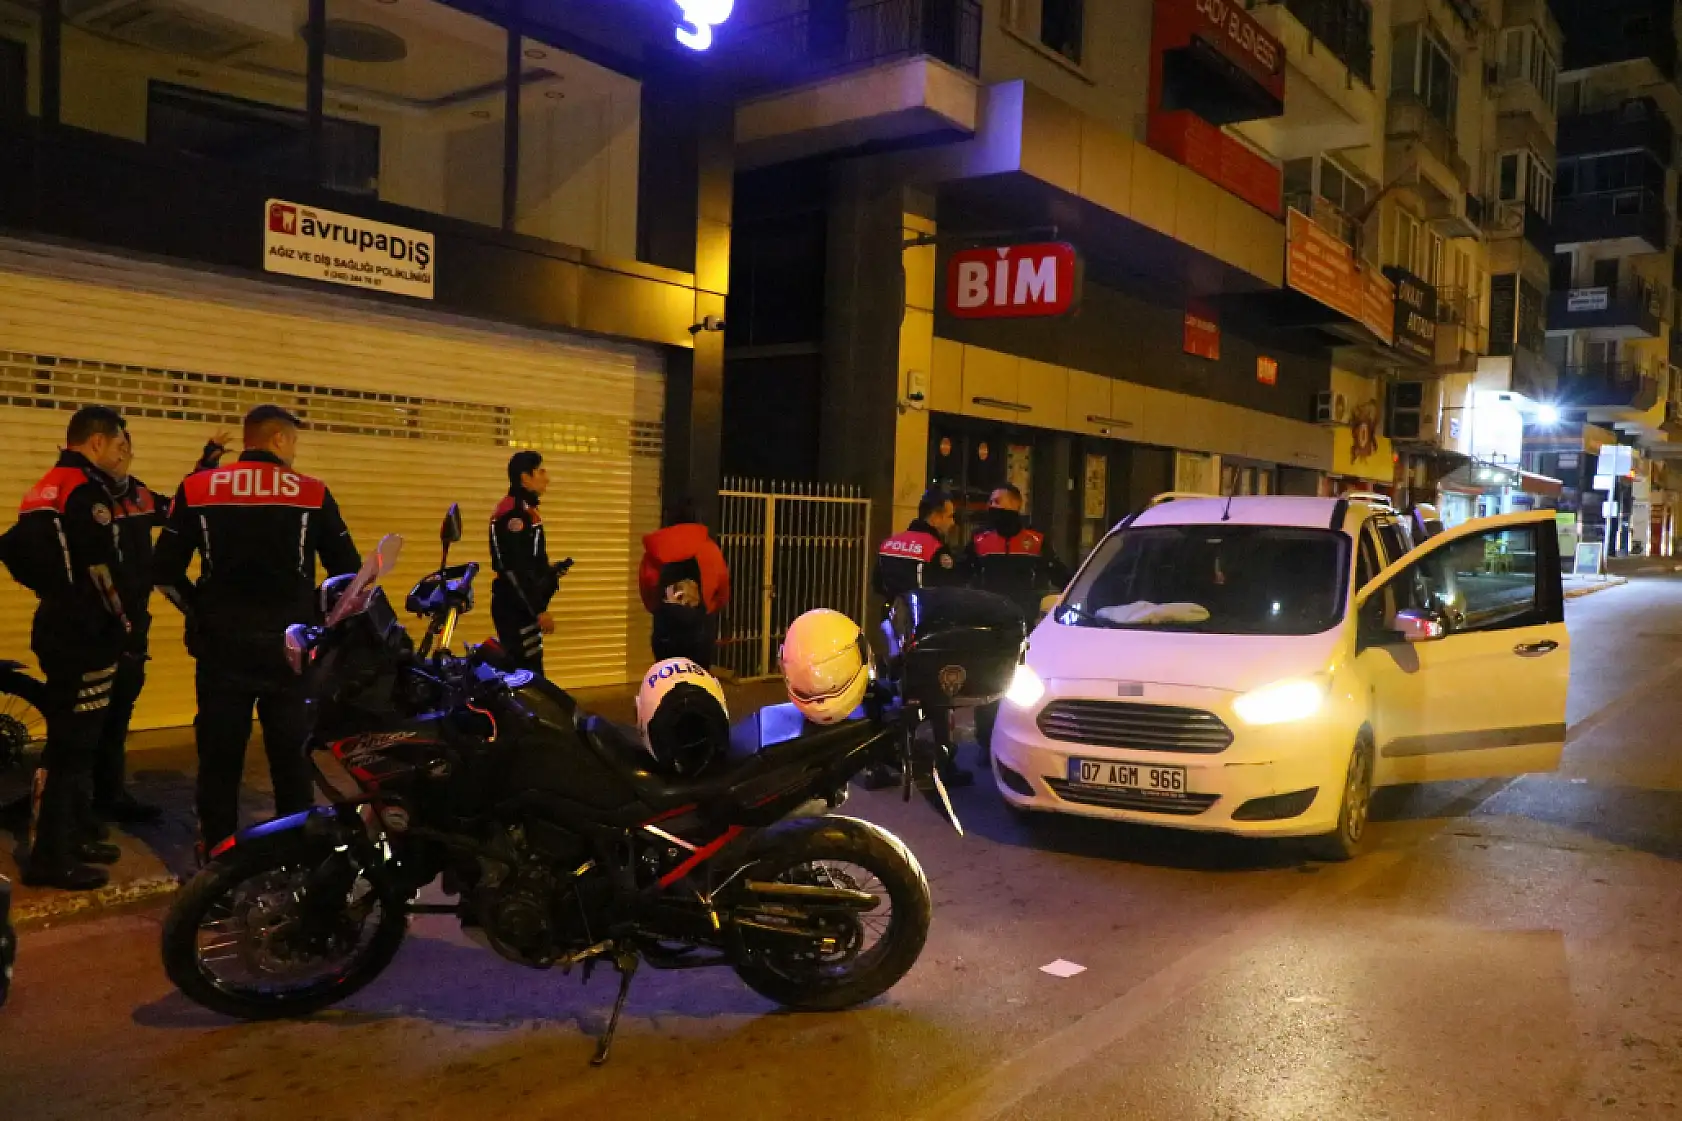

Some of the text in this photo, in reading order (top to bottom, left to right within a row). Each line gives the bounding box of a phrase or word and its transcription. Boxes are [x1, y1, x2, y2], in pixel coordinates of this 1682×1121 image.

[297, 250, 311, 262] VE
[957, 246, 1057, 308] BİM
[209, 467, 301, 496] POLİS
[883, 540, 922, 554] POLİS
[1081, 762, 1101, 780] 07
[1109, 765, 1139, 786] AGM
[1150, 769, 1181, 790] 966
